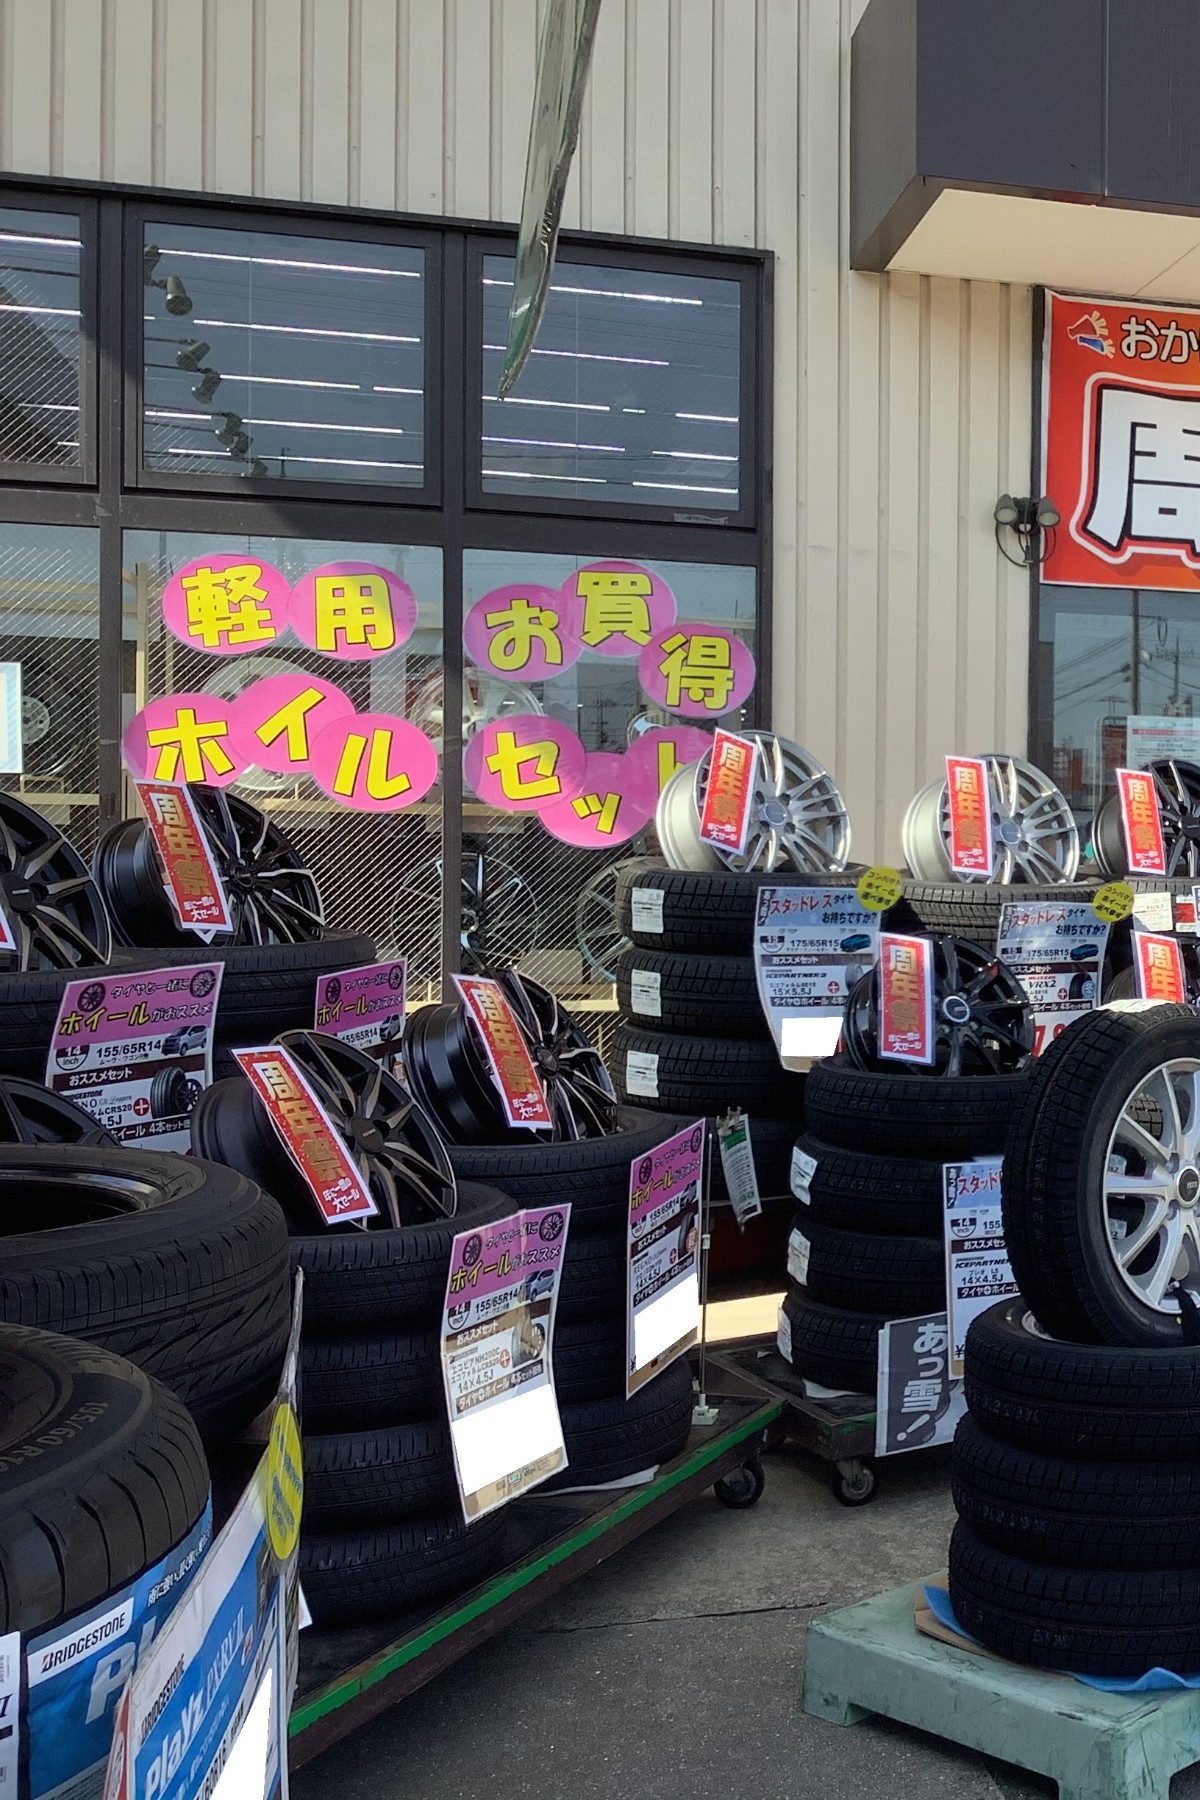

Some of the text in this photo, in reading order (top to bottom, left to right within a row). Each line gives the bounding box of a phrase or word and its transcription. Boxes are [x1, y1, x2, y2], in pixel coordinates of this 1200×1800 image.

[181, 563, 397, 652] 軽用
[485, 570, 734, 710] お買得
[713, 741, 746, 827] 周年祭
[955, 767, 982, 849] 周年祭
[1128, 779, 1158, 851] 周年祭
[150, 793, 212, 896] 周年祭
[790, 939, 840, 948] 175/65R15
[1027, 949, 1070, 958] 175/65R15
[1148, 943, 1178, 1003] 周年
[890, 945, 919, 1033] 周年祭
[1028, 980, 1057, 989] VRX2
[69, 1067, 133, 1086] おススメセット
[96, 1040, 162, 1058] 155/65R14
[471, 989, 534, 1094] 周年祭
[252, 1061, 347, 1183] 周年祭
[957, 1219, 1001, 1230] 14 155
[963, 1239, 1006, 1251] おススメセッ
[474, 1288, 518, 1314] 155/65R14
[896, 1323, 948, 1442] あっ雪！
[41, 1612, 126, 1673] BRIDGESTONE
[146, 1686, 205, 1800] Playz
